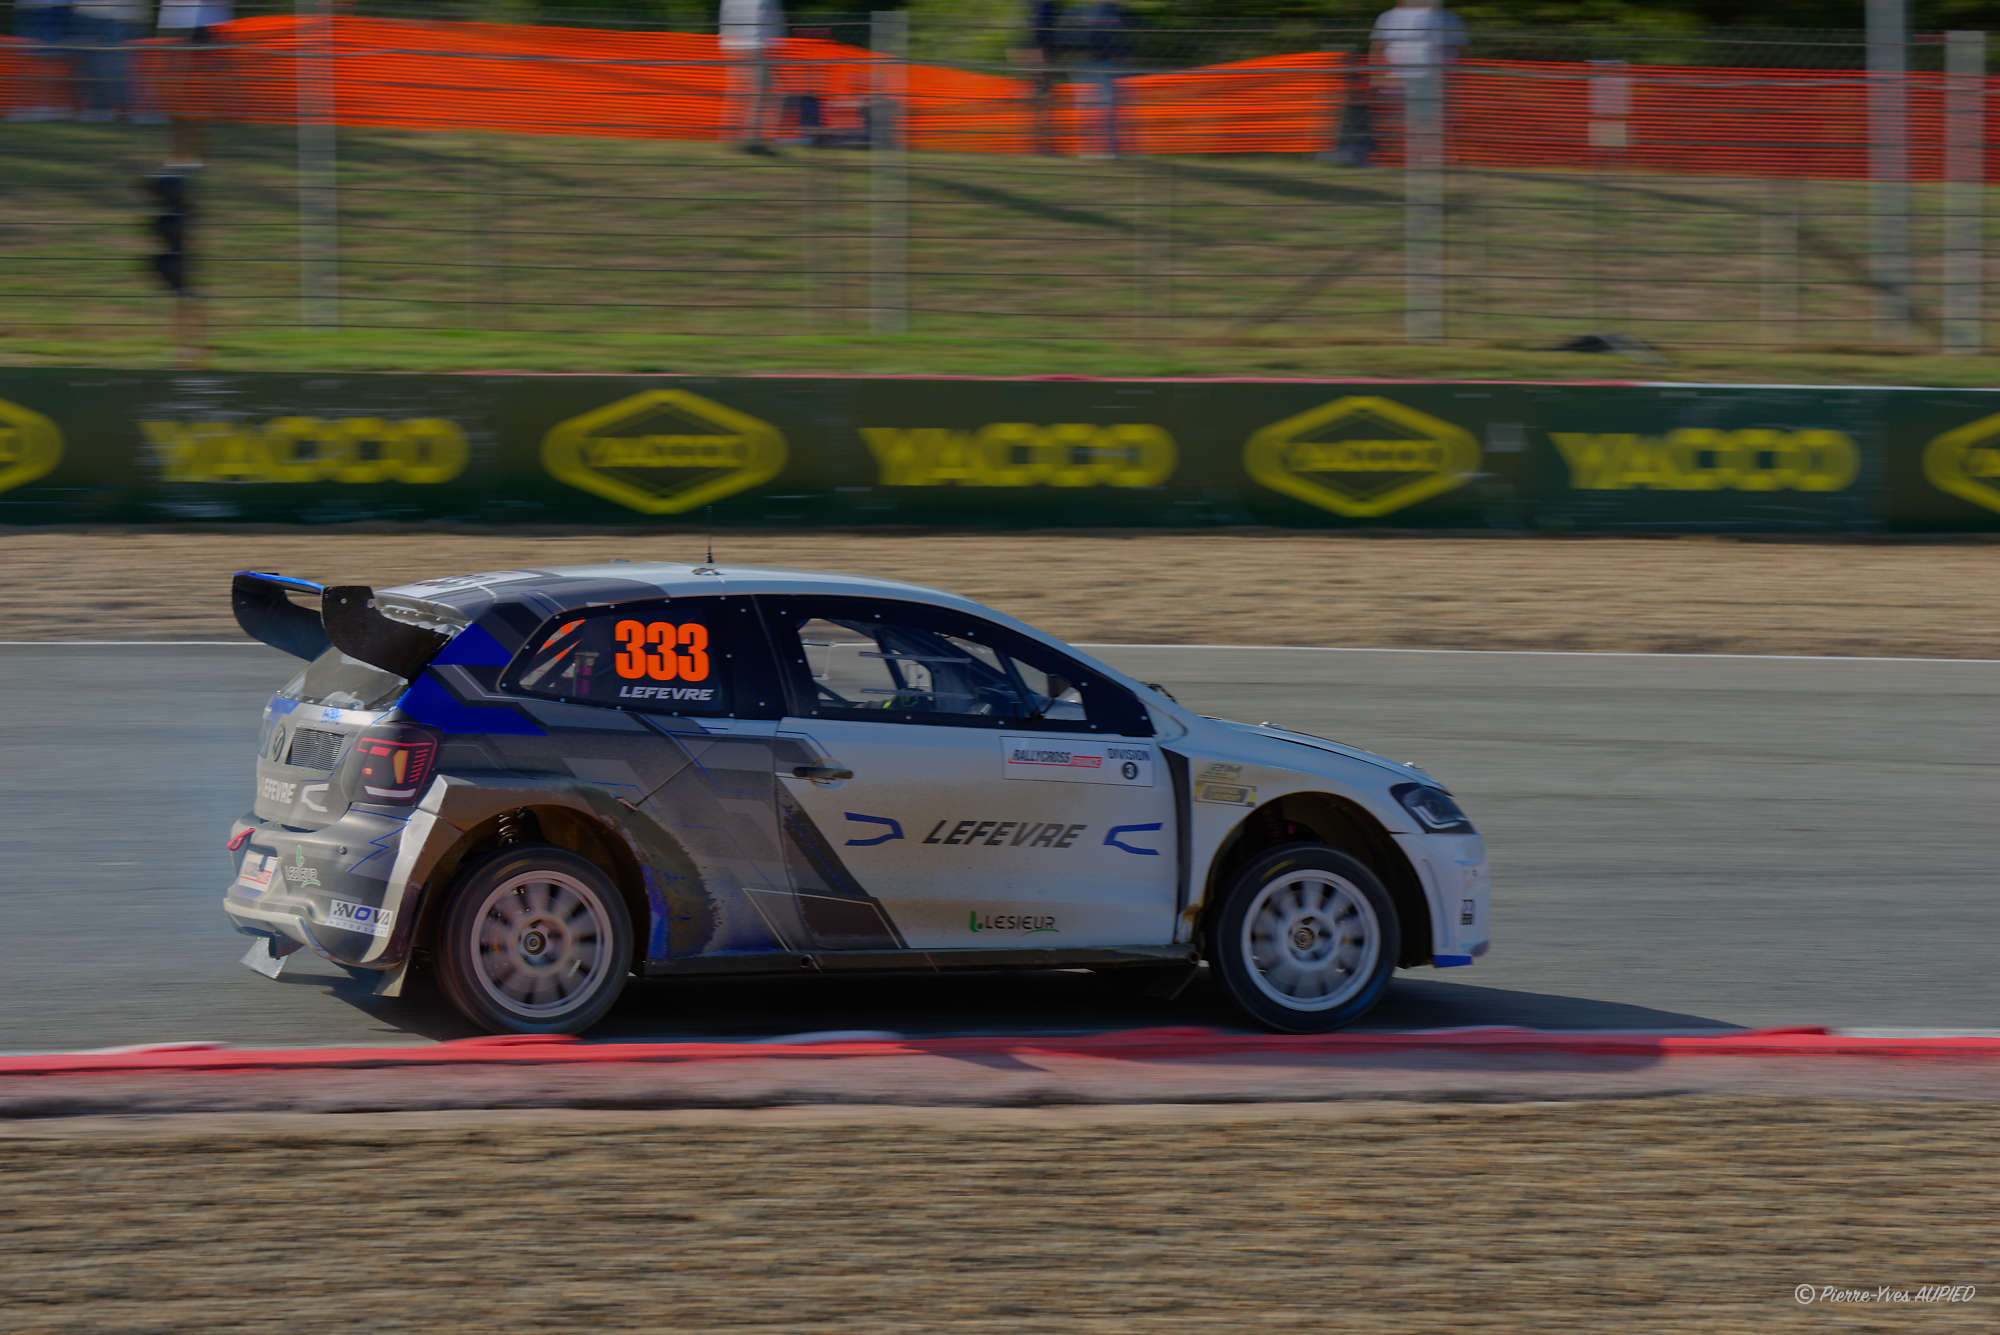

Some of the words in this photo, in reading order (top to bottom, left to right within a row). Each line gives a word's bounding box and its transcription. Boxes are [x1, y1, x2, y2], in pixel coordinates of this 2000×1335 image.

[858, 422, 1178, 488] YACCO
[1548, 428, 1860, 492] YACCO
[615, 619, 709, 682] 333
[619, 685, 715, 701] LEFEVRE
[1012, 749, 1072, 764] RALLYCROSS
[1106, 747, 1150, 761] DIVISION
[922, 819, 1087, 848] LEFEVRE
[335, 902, 392, 926] NOVA
[984, 914, 1056, 930] LESIEUR
